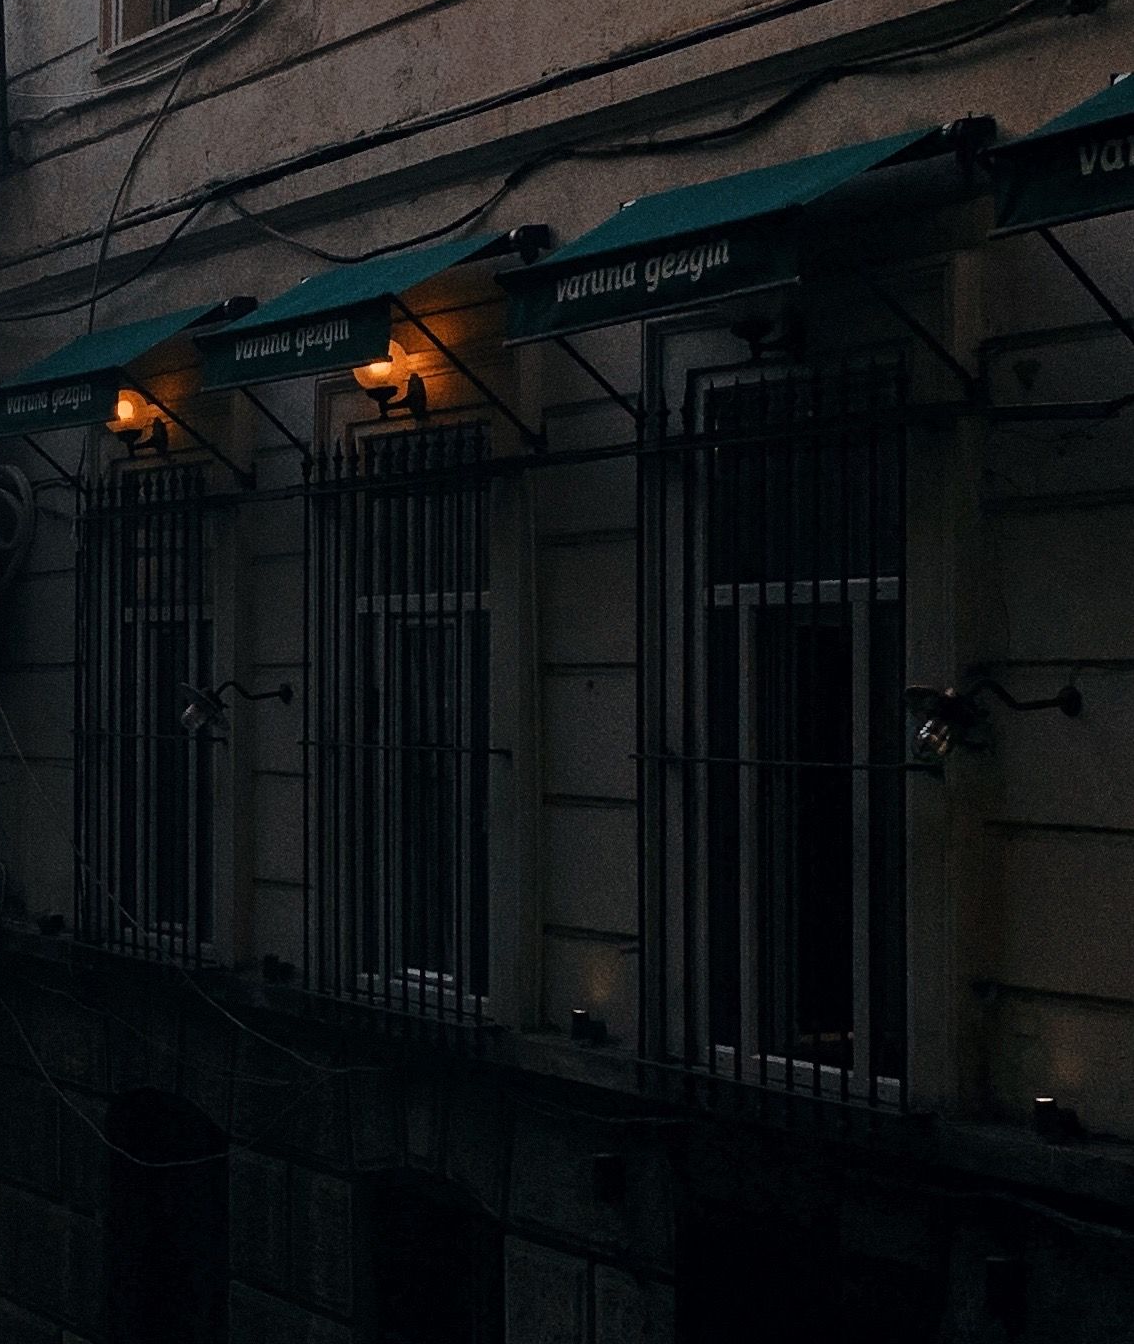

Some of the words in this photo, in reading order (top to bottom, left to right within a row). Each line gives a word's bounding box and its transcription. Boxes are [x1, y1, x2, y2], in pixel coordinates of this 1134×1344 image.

[556, 260, 637, 303] varuna
[643, 238, 730, 293] gezgin
[235, 331, 291, 361] varuna
[295, 318, 350, 358] gezgin
[7, 391, 49, 415] varuna
[52, 382, 92, 414] gezgin
